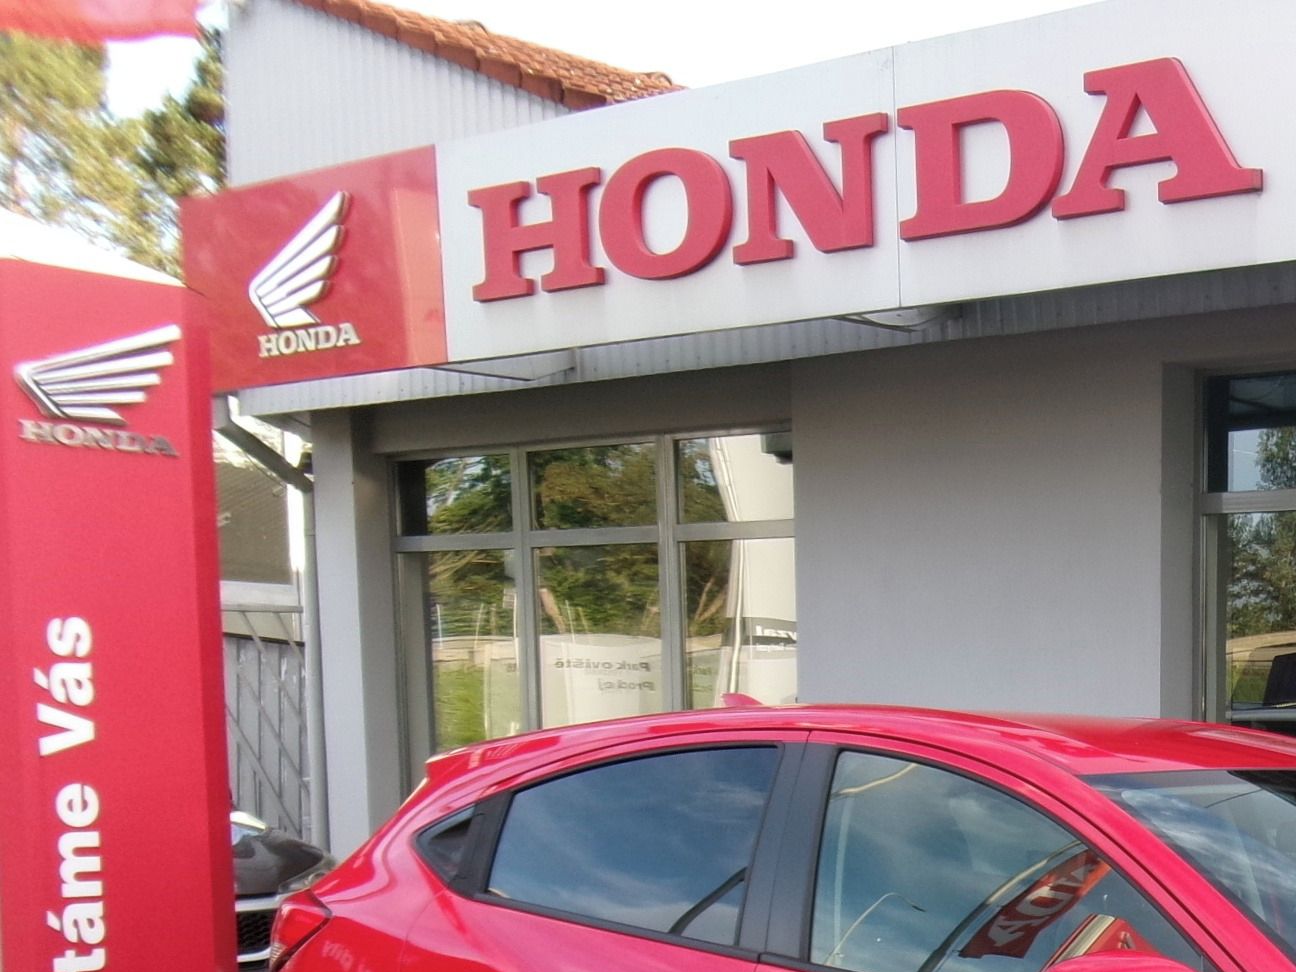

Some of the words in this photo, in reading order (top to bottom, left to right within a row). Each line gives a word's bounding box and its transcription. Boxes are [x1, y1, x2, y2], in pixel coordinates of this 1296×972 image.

[468, 56, 1263, 302] HONDA
[257, 322, 361, 358] HONDA
[18, 418, 179, 459] HONDA
[33, 615, 96, 757] Vás
